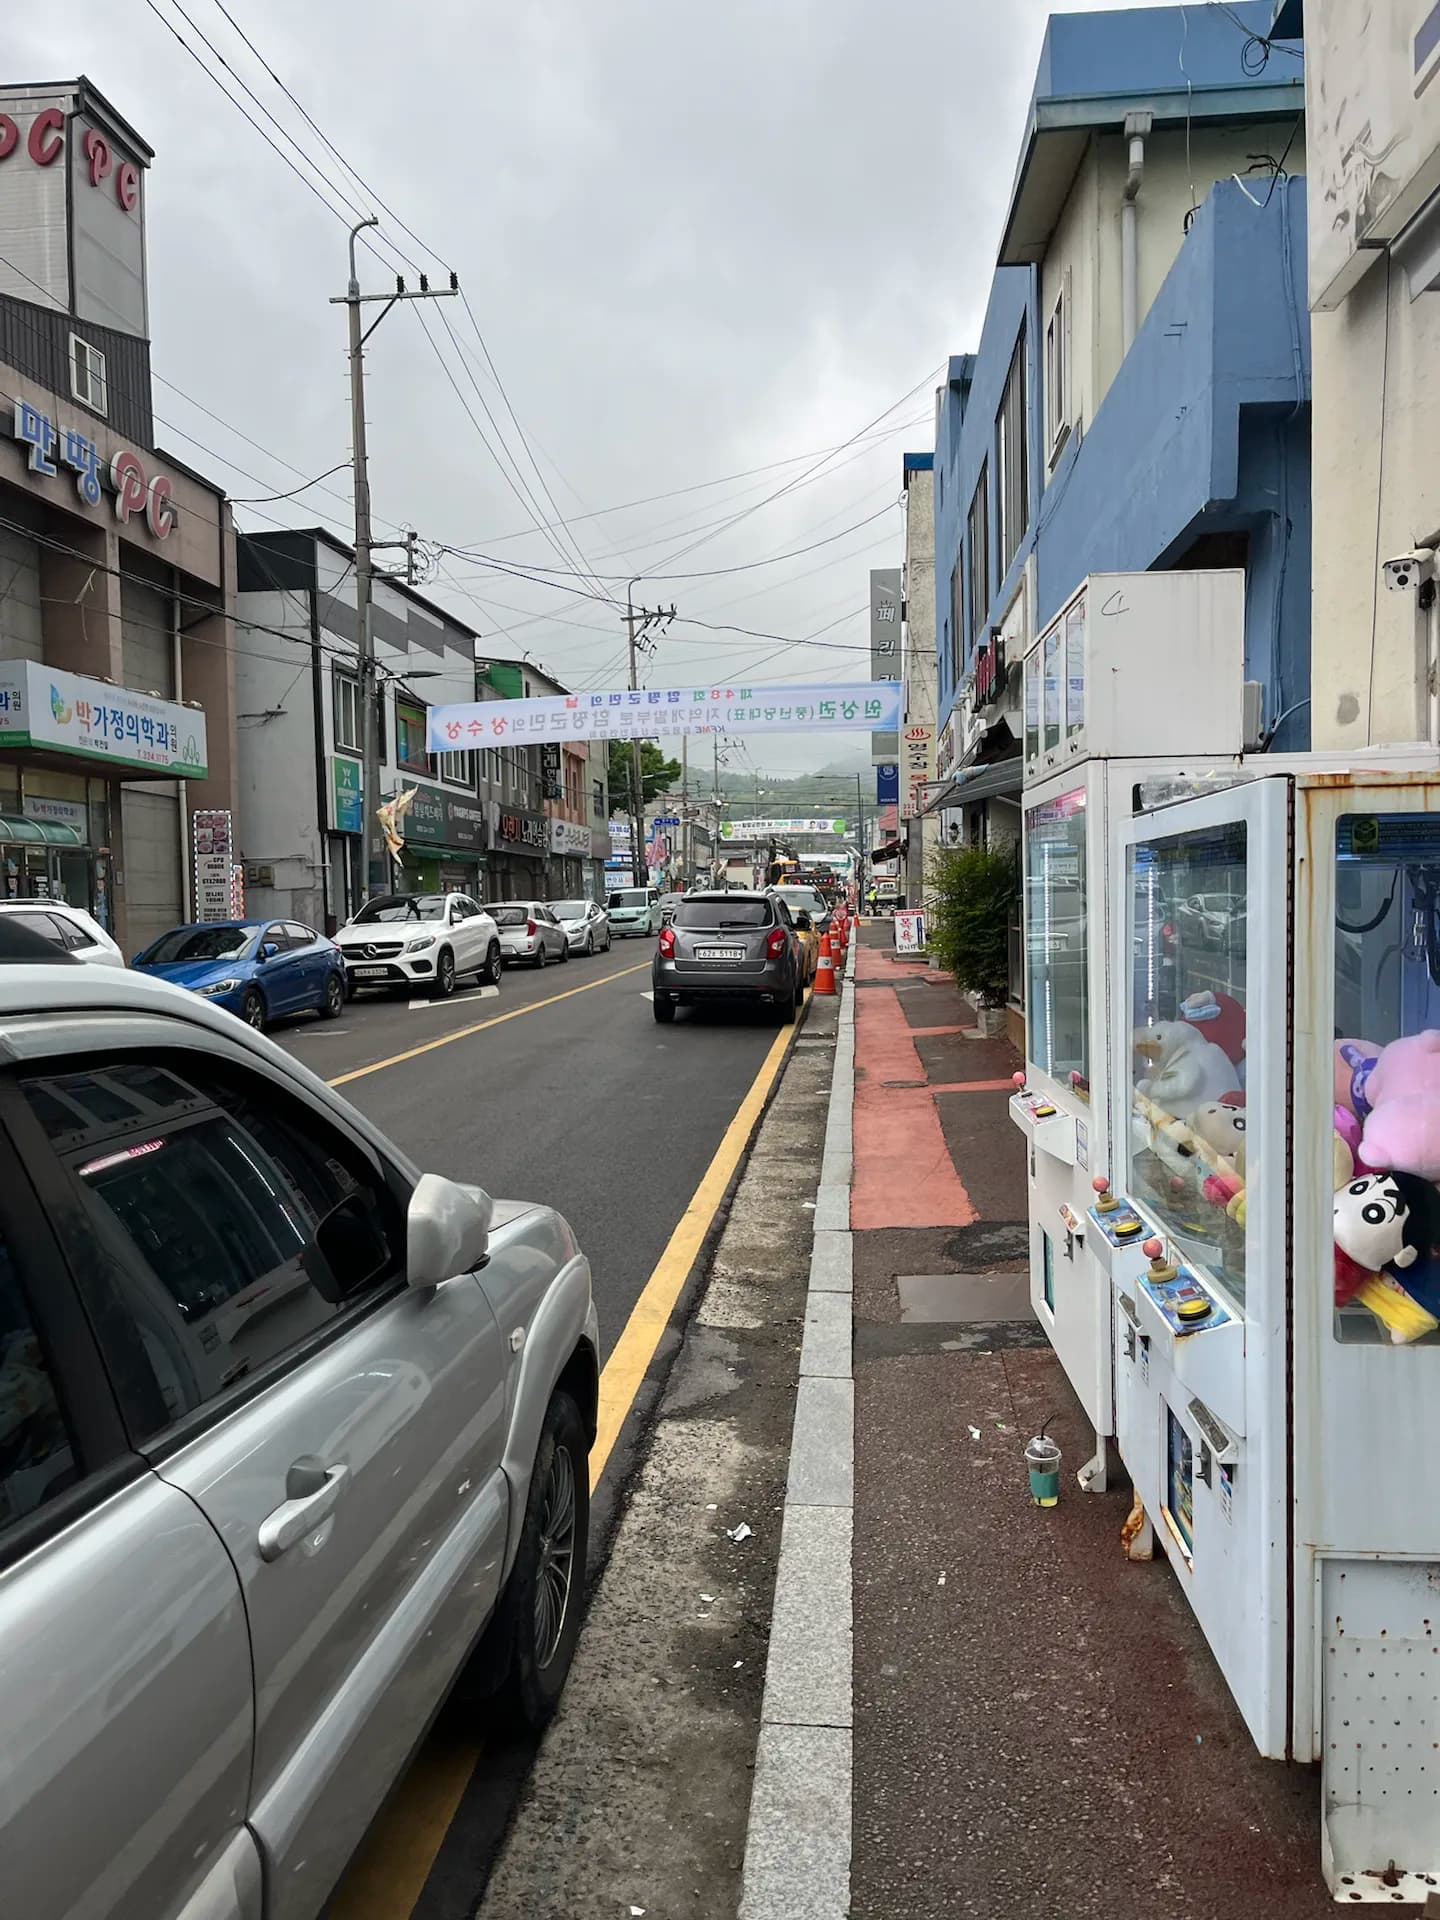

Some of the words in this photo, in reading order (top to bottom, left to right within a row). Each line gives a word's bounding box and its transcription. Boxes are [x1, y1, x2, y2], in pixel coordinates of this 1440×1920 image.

[83, 128, 137, 211] PC
[14, 397, 102, 507] 만땅
[110, 451, 173, 540] PC
[76, 700, 169, 750] 박가정의학과
